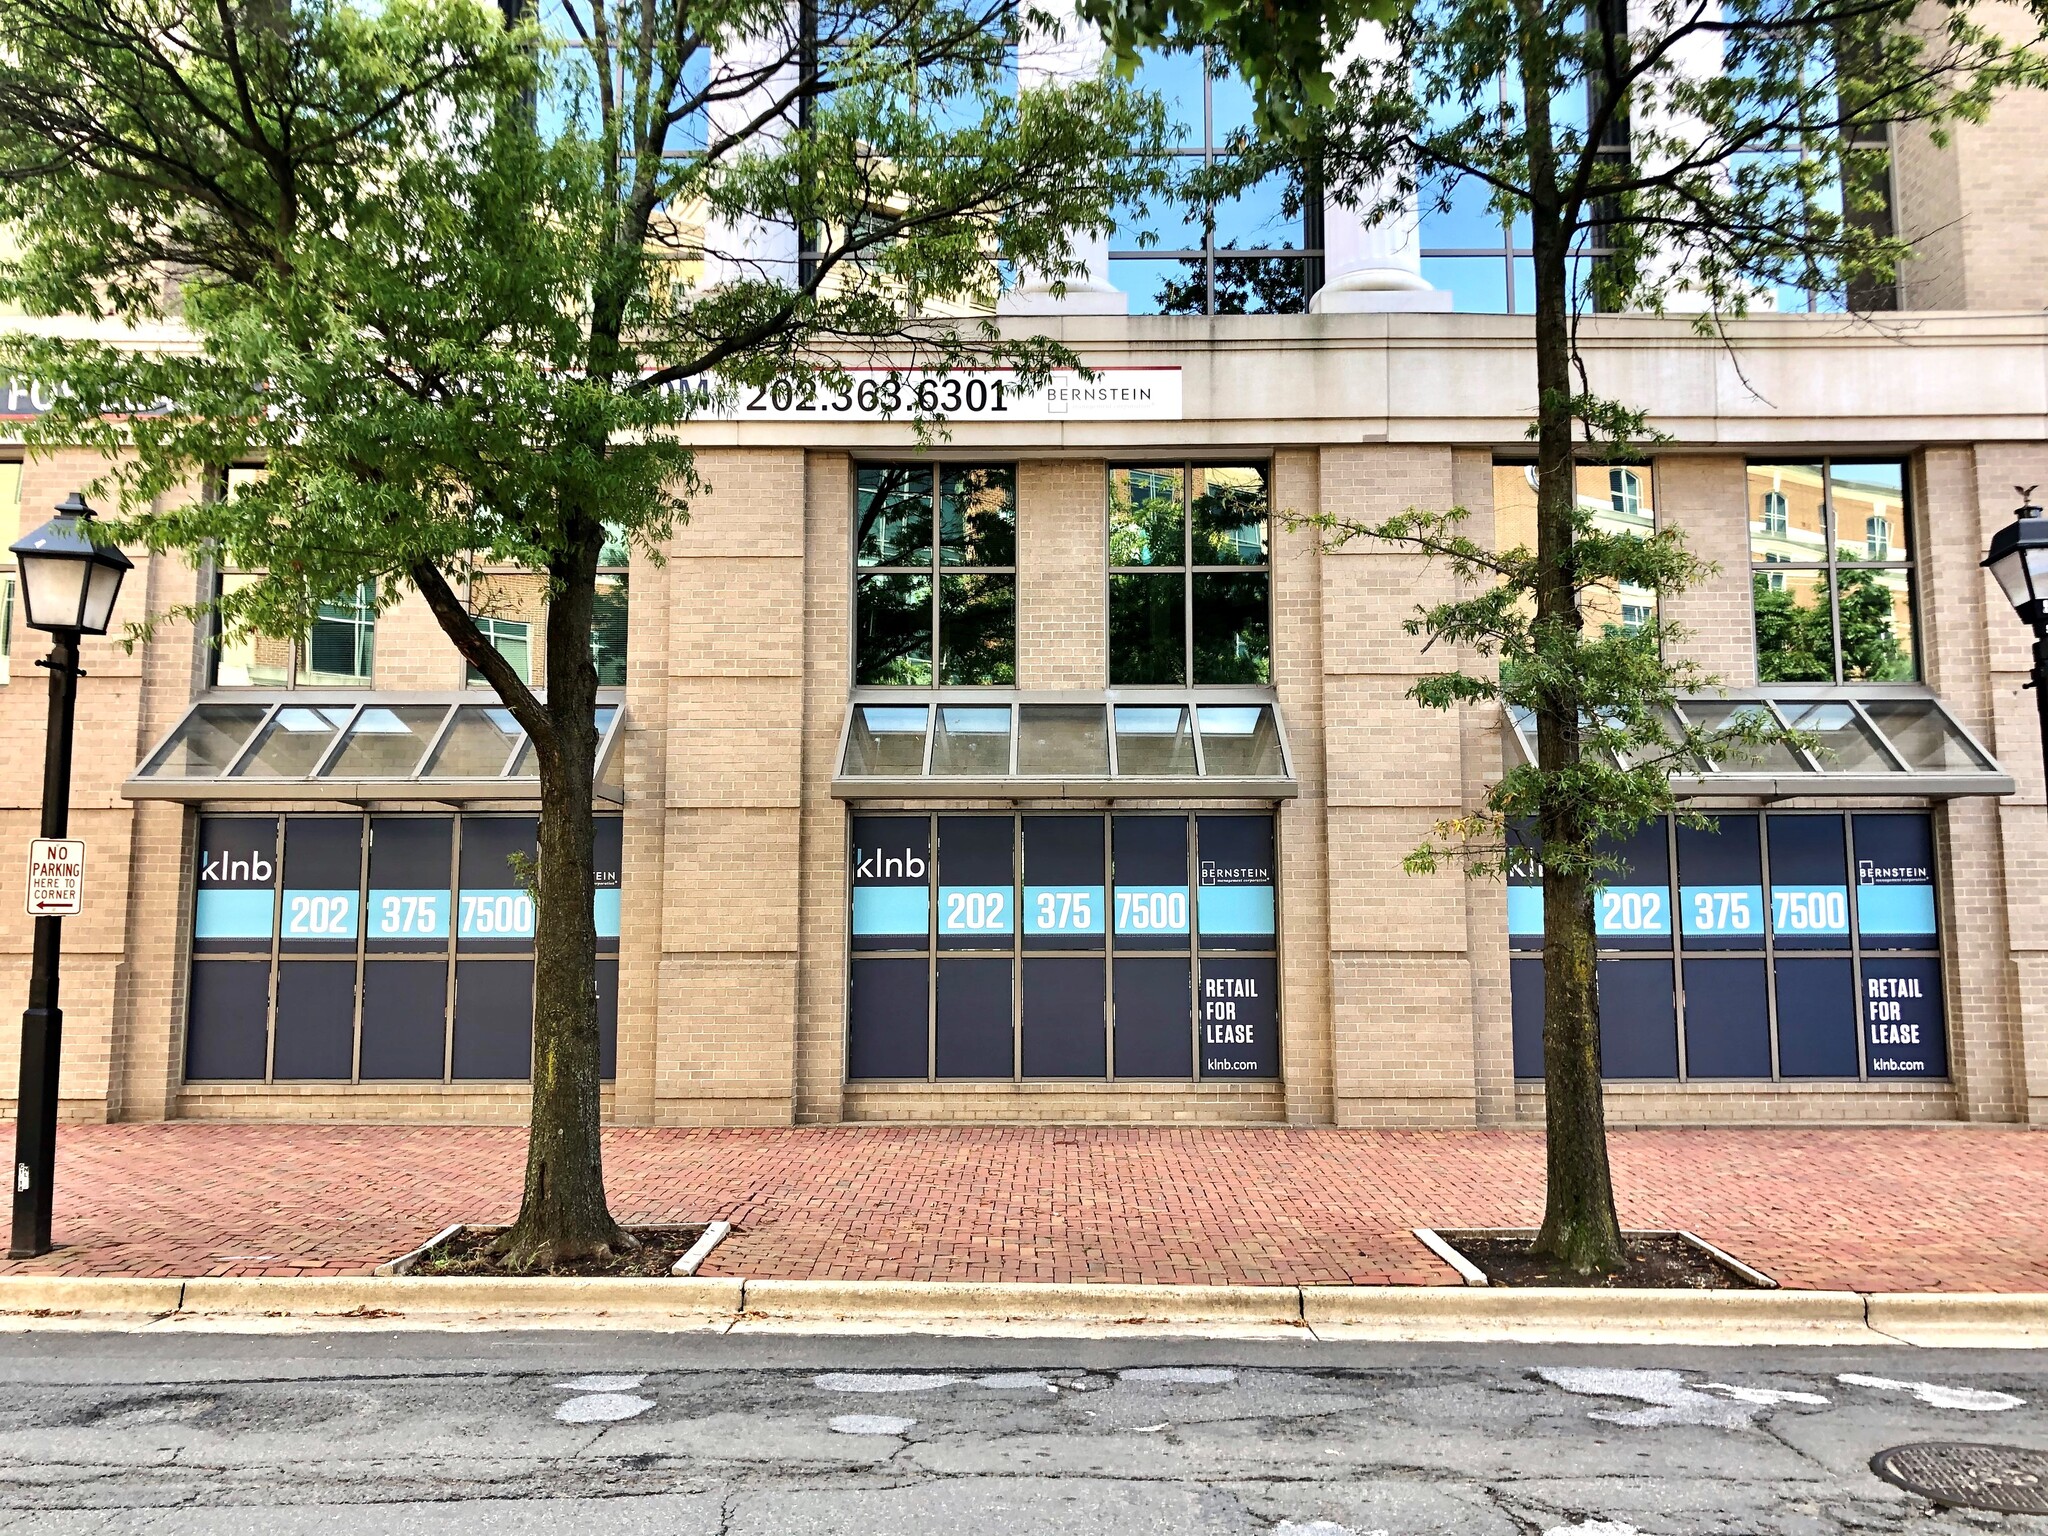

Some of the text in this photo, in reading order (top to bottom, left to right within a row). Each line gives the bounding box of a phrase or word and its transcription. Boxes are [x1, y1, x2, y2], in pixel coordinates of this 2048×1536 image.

[746, 379, 1008, 411] 202.363.6301
[1047, 388, 1151, 401] BERNSTEIN
[47, 846, 68, 860] NO
[856, 848, 925, 878] klnb
[33, 863, 80, 877] PARKING
[202, 850, 273, 881] klnb
[1201, 868, 1268, 878] BERNSTEIN
[1859, 867, 1927, 878] BERNSTEIN
[33, 878, 76, 888] HERE TO
[34, 889, 76, 900] CORNER
[290, 896, 532, 933] 202 375 7500
[947, 893, 1186, 929] 202 375 7500
[1603, 892, 1845, 930] 202 375 7500
[1205, 978, 1258, 998] RETAIL
[1868, 978, 1923, 998] RETAIL
[1206, 1001, 1236, 1020] FOR
[1869, 1001, 1901, 1021] FOR
[1207, 1024, 1254, 1044] LEASE
[1871, 1024, 1920, 1044] LEASE
[1207, 1058, 1258, 1071] klnb.com
[1873, 1058, 1925, 1071] klnb.com
